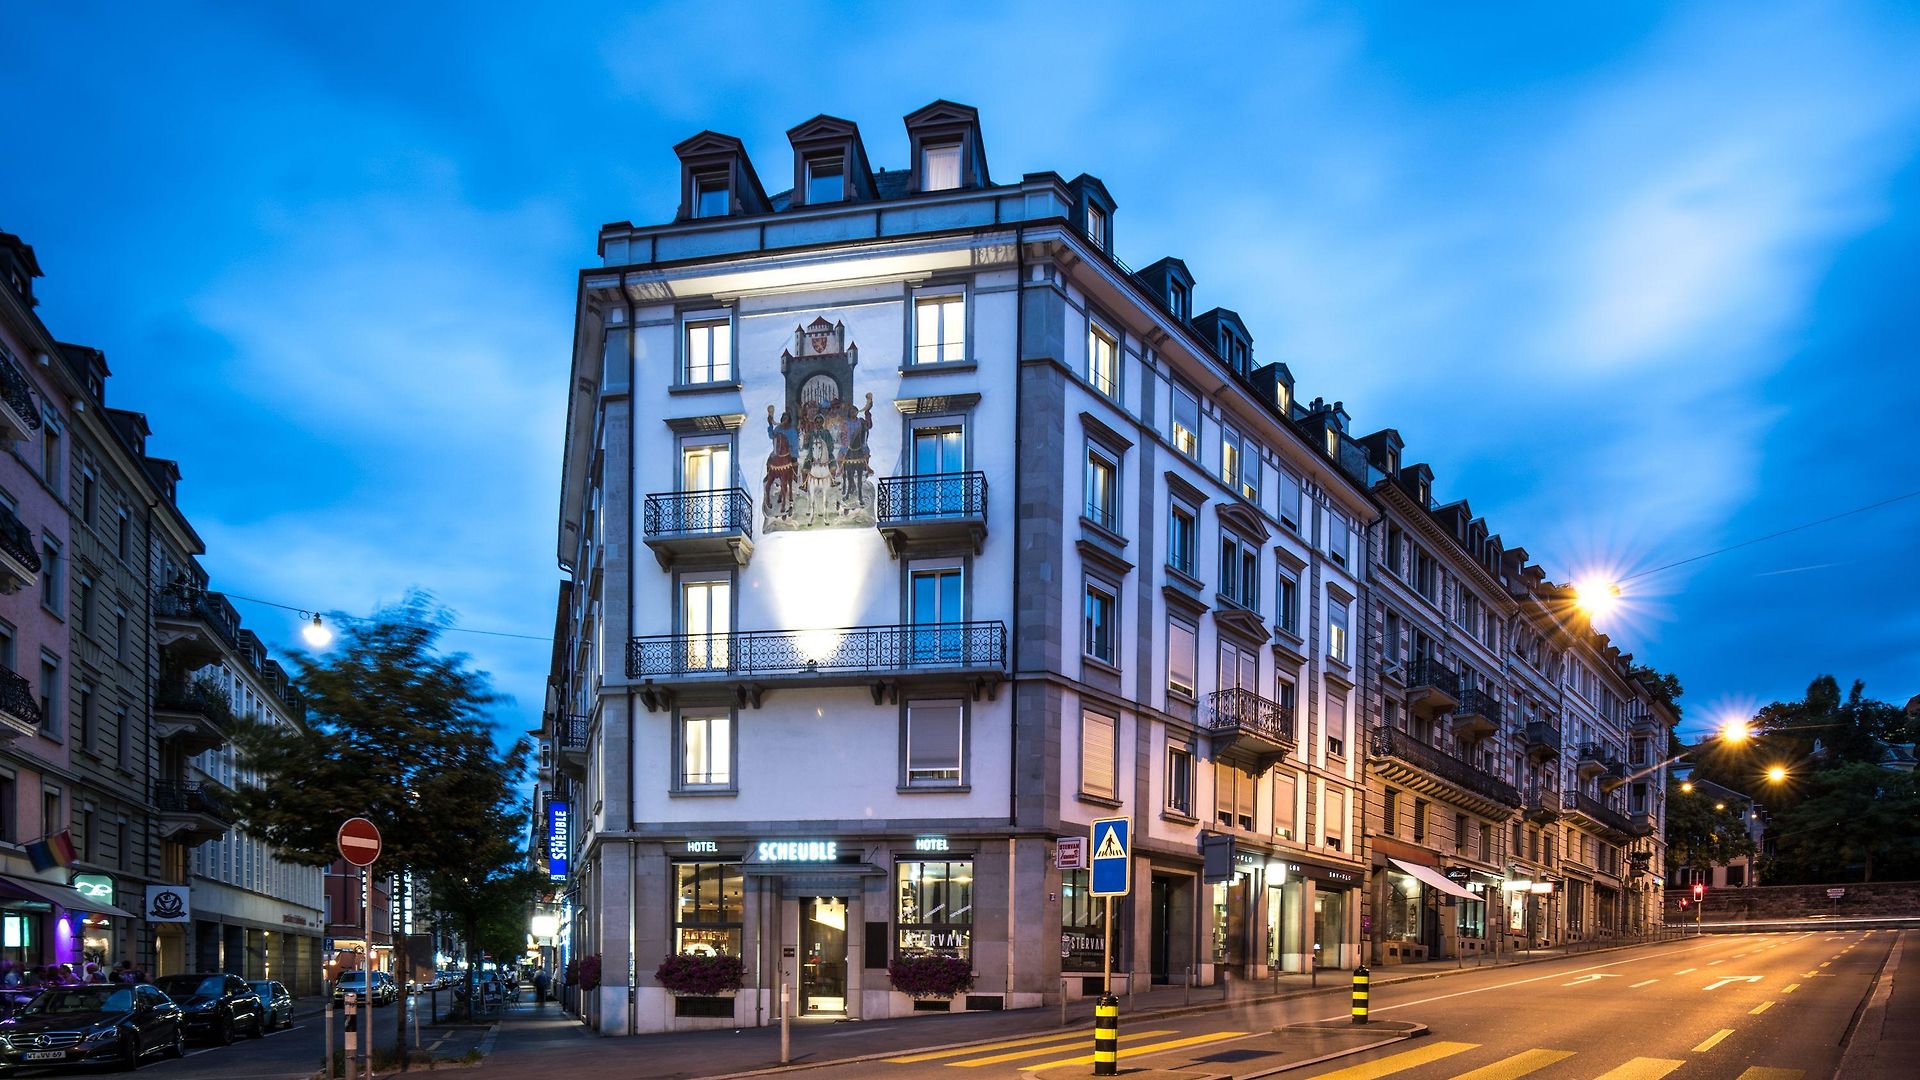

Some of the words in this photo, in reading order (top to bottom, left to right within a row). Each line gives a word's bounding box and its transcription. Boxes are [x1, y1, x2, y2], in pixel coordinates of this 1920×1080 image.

[552, 810, 567, 860] SCHEUBLE
[687, 841, 718, 852] HOTEL
[758, 841, 837, 861] SCHEUBLE
[916, 839, 949, 851] HOTEL
[1071, 936, 1105, 950] STERVAN
